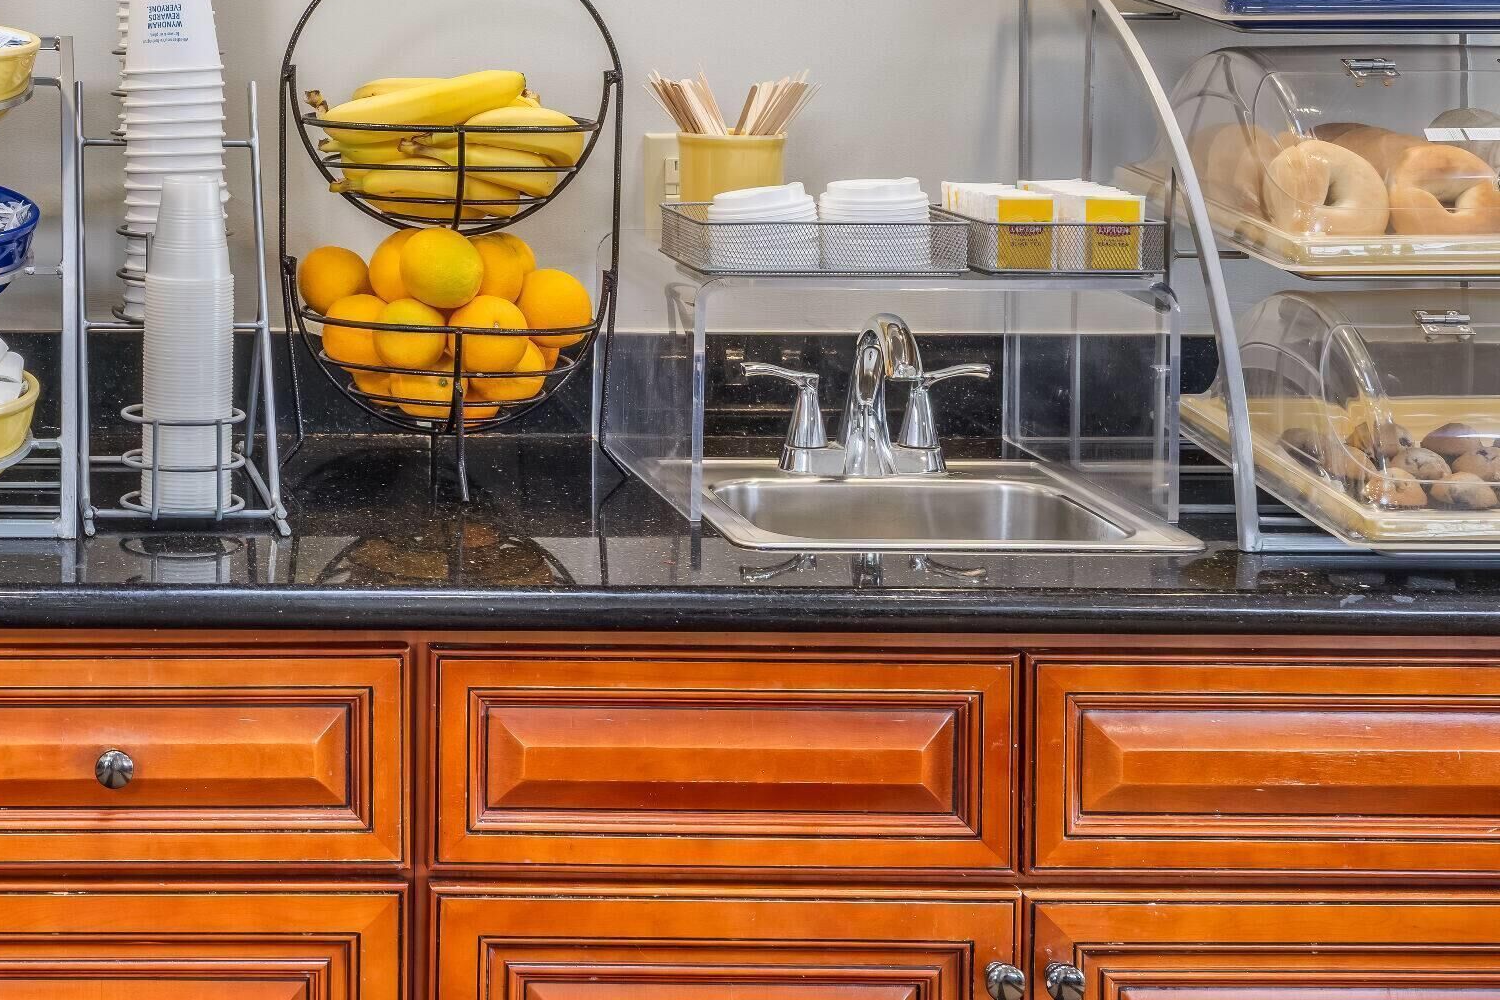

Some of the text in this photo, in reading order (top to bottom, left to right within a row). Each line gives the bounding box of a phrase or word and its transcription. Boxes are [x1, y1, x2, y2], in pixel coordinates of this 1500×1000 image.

[146, 3, 182, 14] EVERYONE.
[148, 12, 181, 22] REWARDS
[147, 20, 183, 29] WYNDHAM
